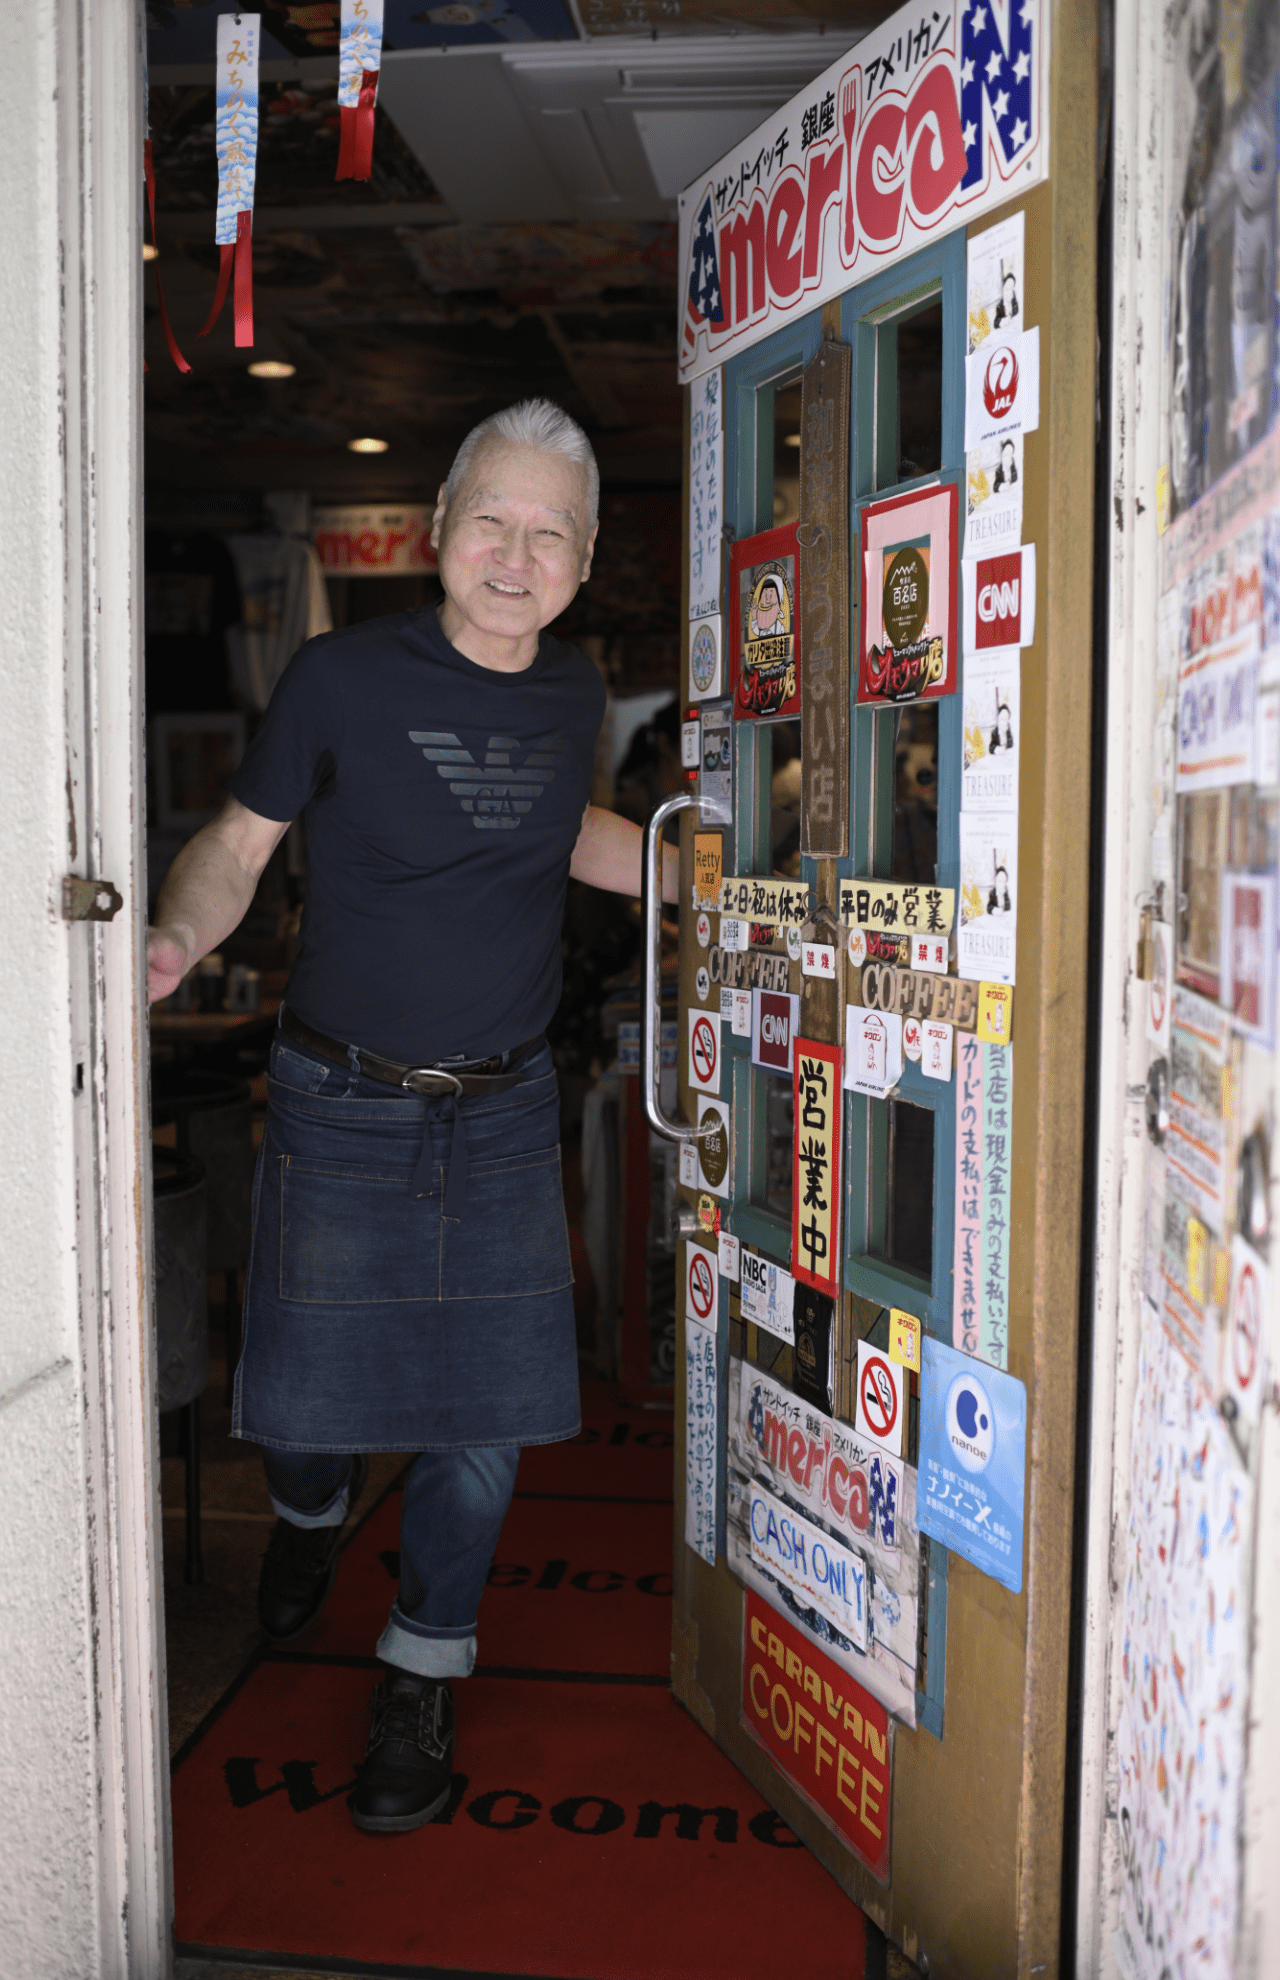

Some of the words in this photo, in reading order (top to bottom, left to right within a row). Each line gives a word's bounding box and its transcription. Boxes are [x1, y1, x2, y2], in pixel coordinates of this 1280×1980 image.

[715, 127, 790, 213] サンドイッチ
[801, 91, 835, 151] 銀座
[864, 11, 952, 101] アメリカン
[991, 394, 1012, 414] JAL
[980, 428, 997, 441] JAPAN
[997, 421, 1022, 436] AIRLINES
[968, 508, 1018, 542] TREASURE
[893, 582, 918, 606] 百名店
[977, 578, 1020, 623] CNN
[964, 774, 1014, 798] TREASURE
[695, 849, 721, 873] Retty
[723, 881, 807, 924] 土・日・祝は休み
[840, 886, 946, 933] 平日のみ営業
[806, 949, 830, 970] 禁煙
[918, 943, 944, 965] 禁煙
[962, 932, 1010, 959] TREASURE
[709, 946, 790, 992] COFFEE
[861, 963, 980, 1029] COFFEE
[761, 1013, 788, 1047] CNN
[863, 1031, 882, 1042] キクロン
[927, 1028, 948, 1040] キクロン
[798, 1058, 829, 1279] 営業中
[959, 1039, 980, 1353] カードの支払いはできません
[743, 1253, 767, 1287] NBC
[743, 1276, 755, 1289] RADIO
[755, 1281, 767, 1294] SAGA
[805, 1413, 821, 1438] 銀座
[833, 1432, 867, 1465] アメリカン
[951, 1434, 987, 1461] nanoe
[751, 1498, 807, 1576] CASH
[812, 1543, 864, 1621] ONLY
[750, 1615, 887, 1766] CARAVAN
[749, 1662, 885, 1840] COFFEE
